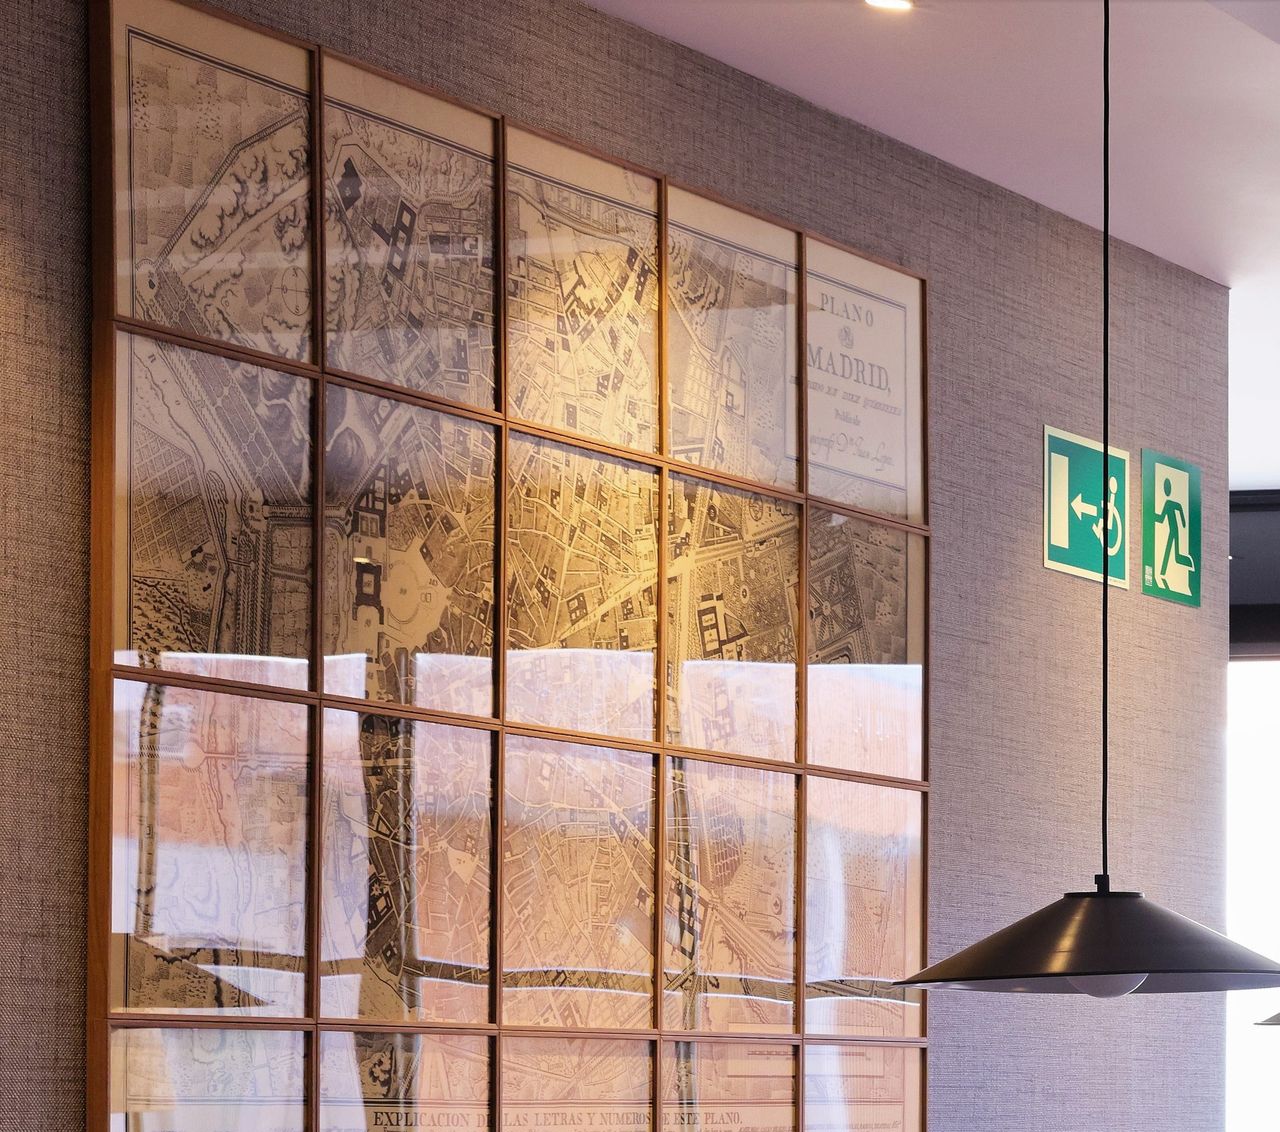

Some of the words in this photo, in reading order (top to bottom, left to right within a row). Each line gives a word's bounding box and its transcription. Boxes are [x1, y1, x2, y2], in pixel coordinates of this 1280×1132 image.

[819, 292, 874, 328] PLANO
[373, 1111, 470, 1128] EXPLICACION
[535, 1112, 583, 1127] LETRAS
[587, 1112, 596, 1126] Y
[599, 1112, 651, 1126] NUMEROS
[673, 1112, 700, 1125] ESTE
